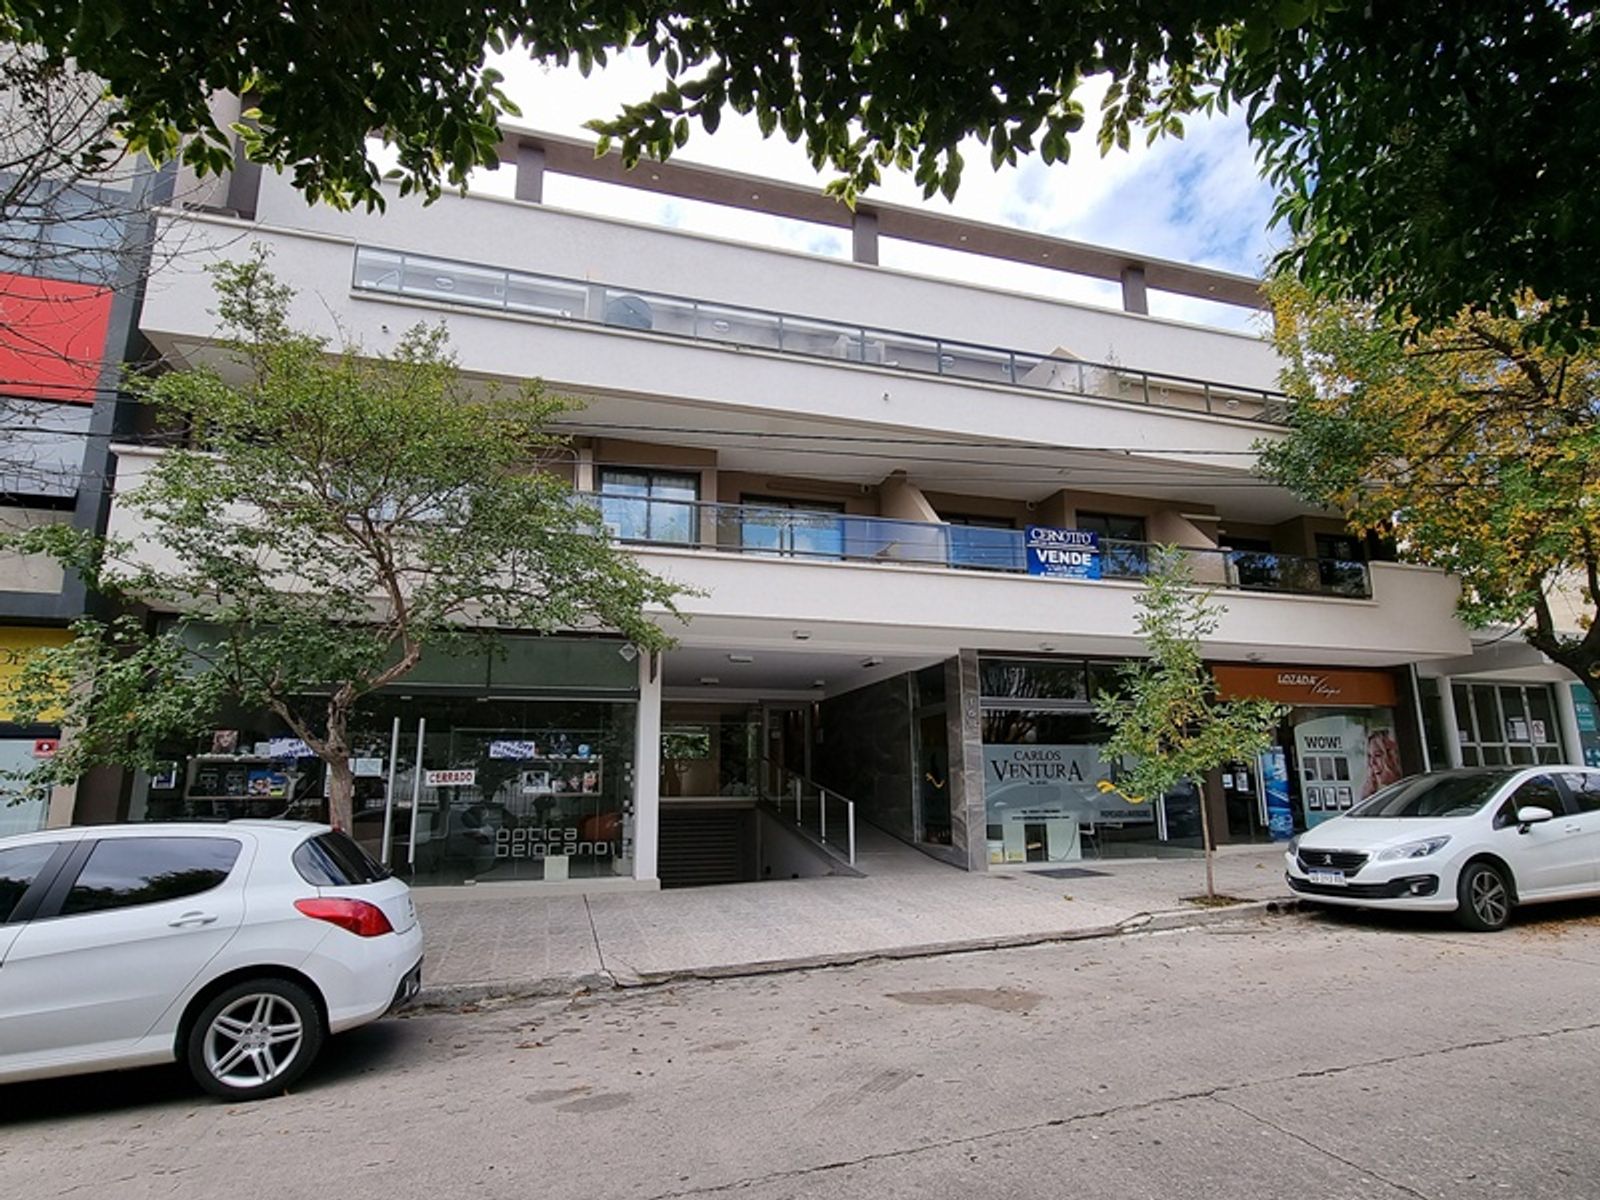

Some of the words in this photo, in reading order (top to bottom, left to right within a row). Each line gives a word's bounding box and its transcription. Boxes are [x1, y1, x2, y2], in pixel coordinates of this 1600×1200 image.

[1036, 549, 1092, 566] VENDE
[1304, 736, 1343, 749] WOW!
[1013, 750, 1062, 761] CARLOS
[990, 759, 1084, 782] VENTURA
[429, 771, 473, 784] CERRADO
